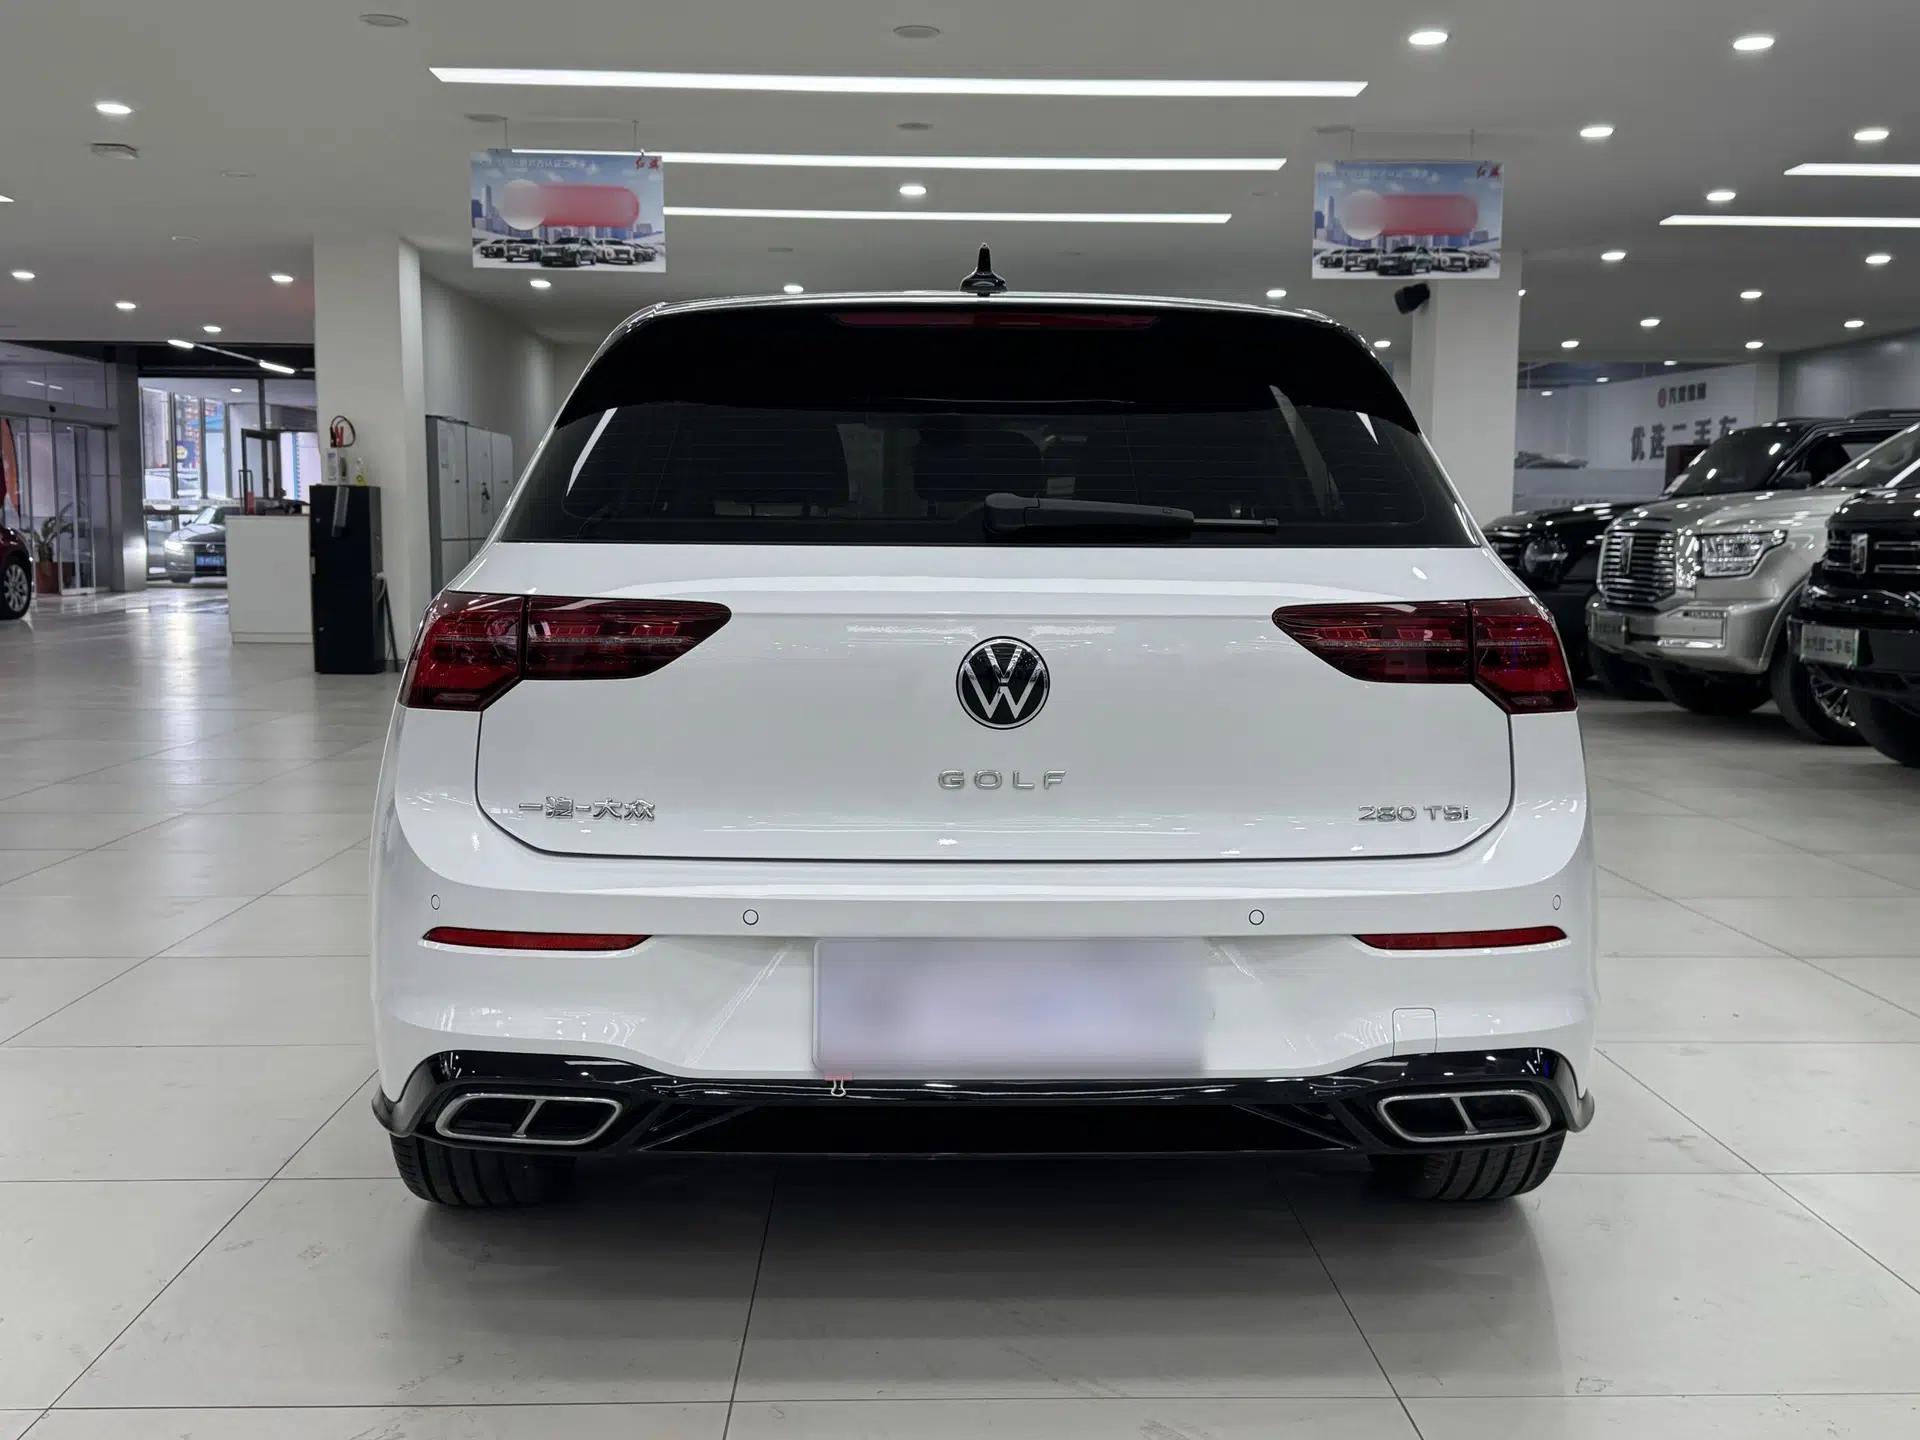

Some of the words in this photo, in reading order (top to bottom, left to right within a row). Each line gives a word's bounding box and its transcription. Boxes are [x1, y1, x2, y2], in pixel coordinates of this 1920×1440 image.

[959, 643, 1045, 721] VW
[938, 769, 1066, 790] GOLF
[1359, 805, 1417, 822] 280
